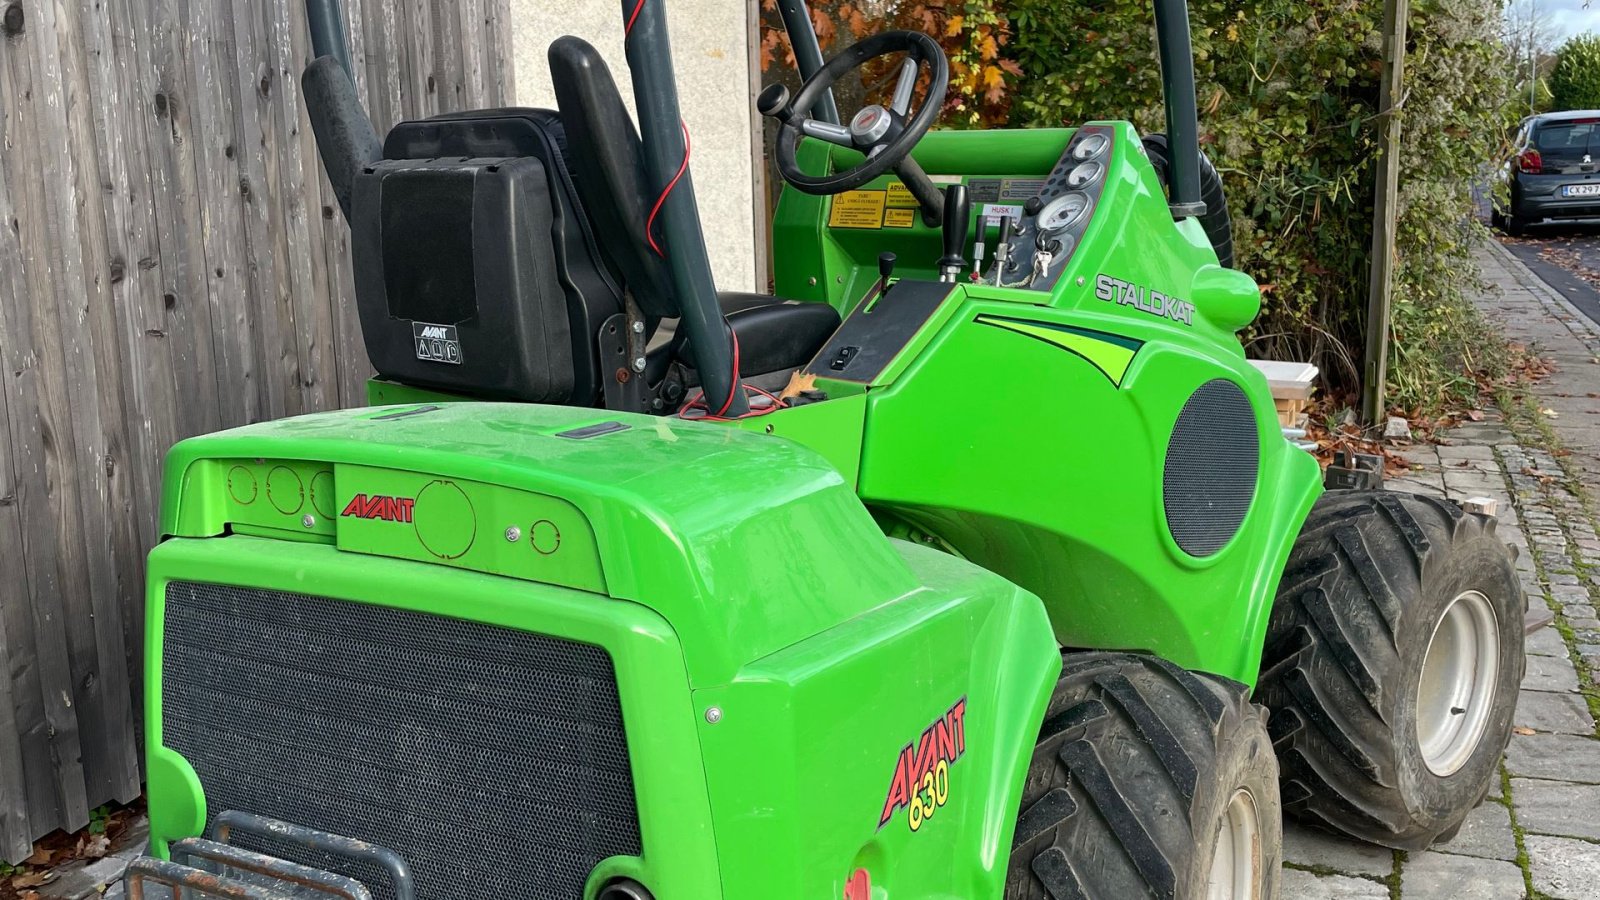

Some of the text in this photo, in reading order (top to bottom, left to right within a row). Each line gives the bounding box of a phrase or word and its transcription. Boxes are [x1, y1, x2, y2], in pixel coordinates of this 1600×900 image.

[1569, 186, 1580, 194] CX
[991, 206, 1010, 214] HUSK
[1095, 273, 1195, 326] STALDKAT
[421, 326, 448, 339] AVANT
[341, 493, 414, 523] AVANT
[878, 697, 966, 829] AVANT
[908, 758, 949, 832] 630
